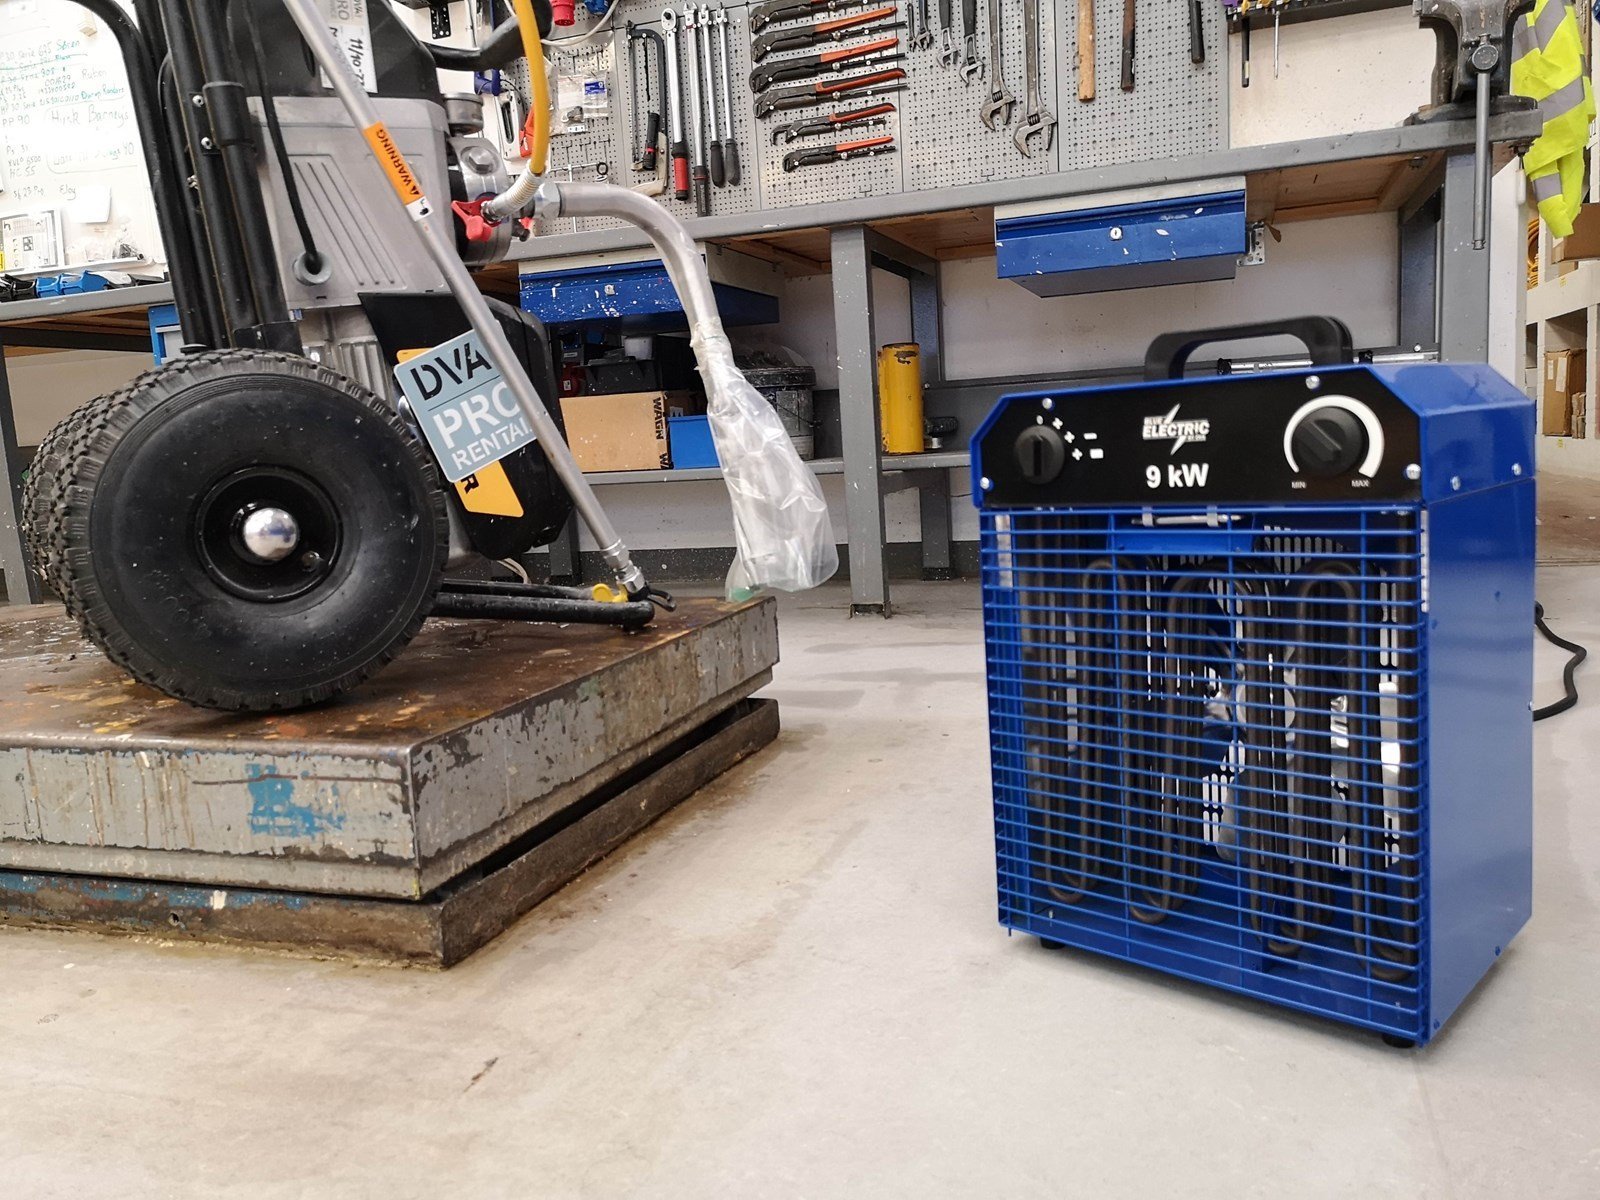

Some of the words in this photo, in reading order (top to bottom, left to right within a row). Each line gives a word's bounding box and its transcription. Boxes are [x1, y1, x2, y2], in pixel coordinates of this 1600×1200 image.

[376, 129, 412, 186] WARNING
[409, 342, 493, 401] DVA
[1143, 420, 1210, 440] ELECTRIC
[1145, 464, 1162, 489] 9
[1167, 462, 1210, 488] kW
[1291, 481, 1307, 489] MIN
[1351, 479, 1370, 488] MAX
